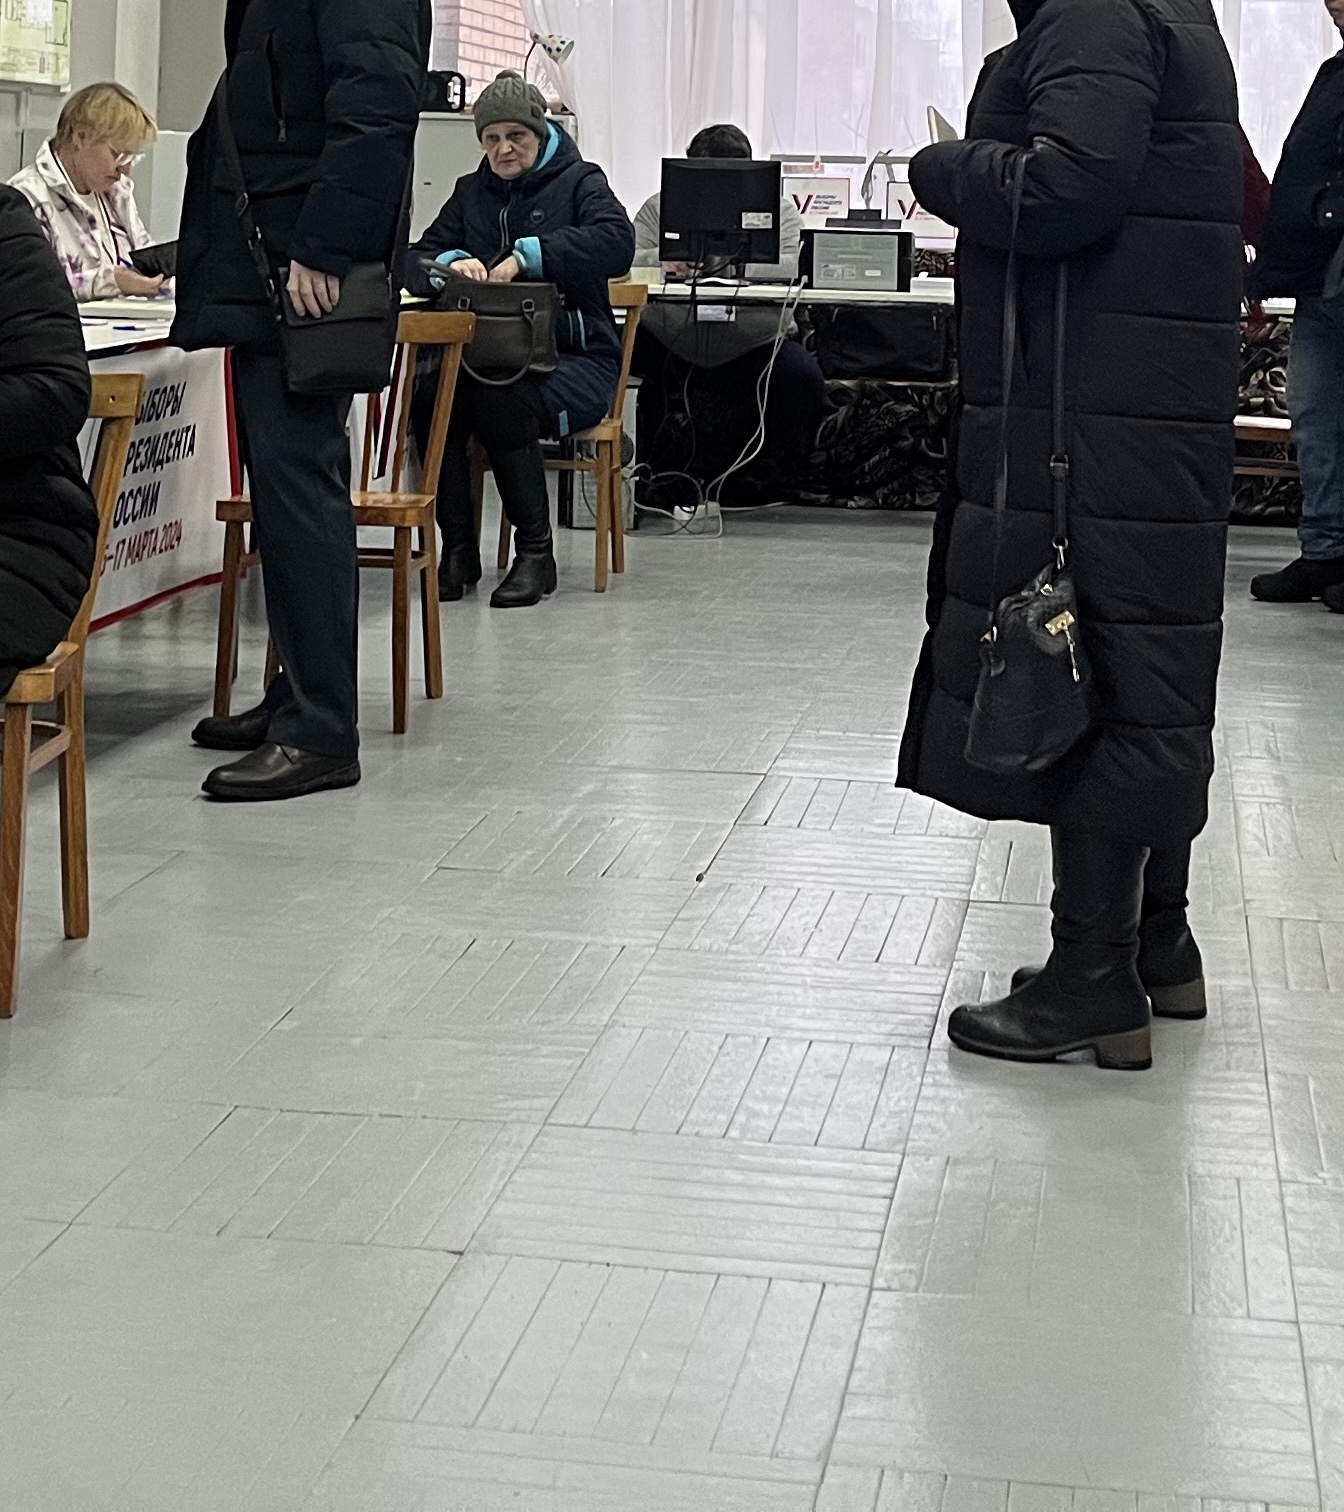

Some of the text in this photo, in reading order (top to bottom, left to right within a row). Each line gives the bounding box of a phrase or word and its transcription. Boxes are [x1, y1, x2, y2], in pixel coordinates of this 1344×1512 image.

[135, 381, 186, 426] ЫБОРЫ
[123, 424, 196, 477] РЕЗИДЕНТА
[113, 480, 161, 529] ОССИИ
[124, 527, 159, 568] МАРТА
[159, 518, 182, 554] 2024
